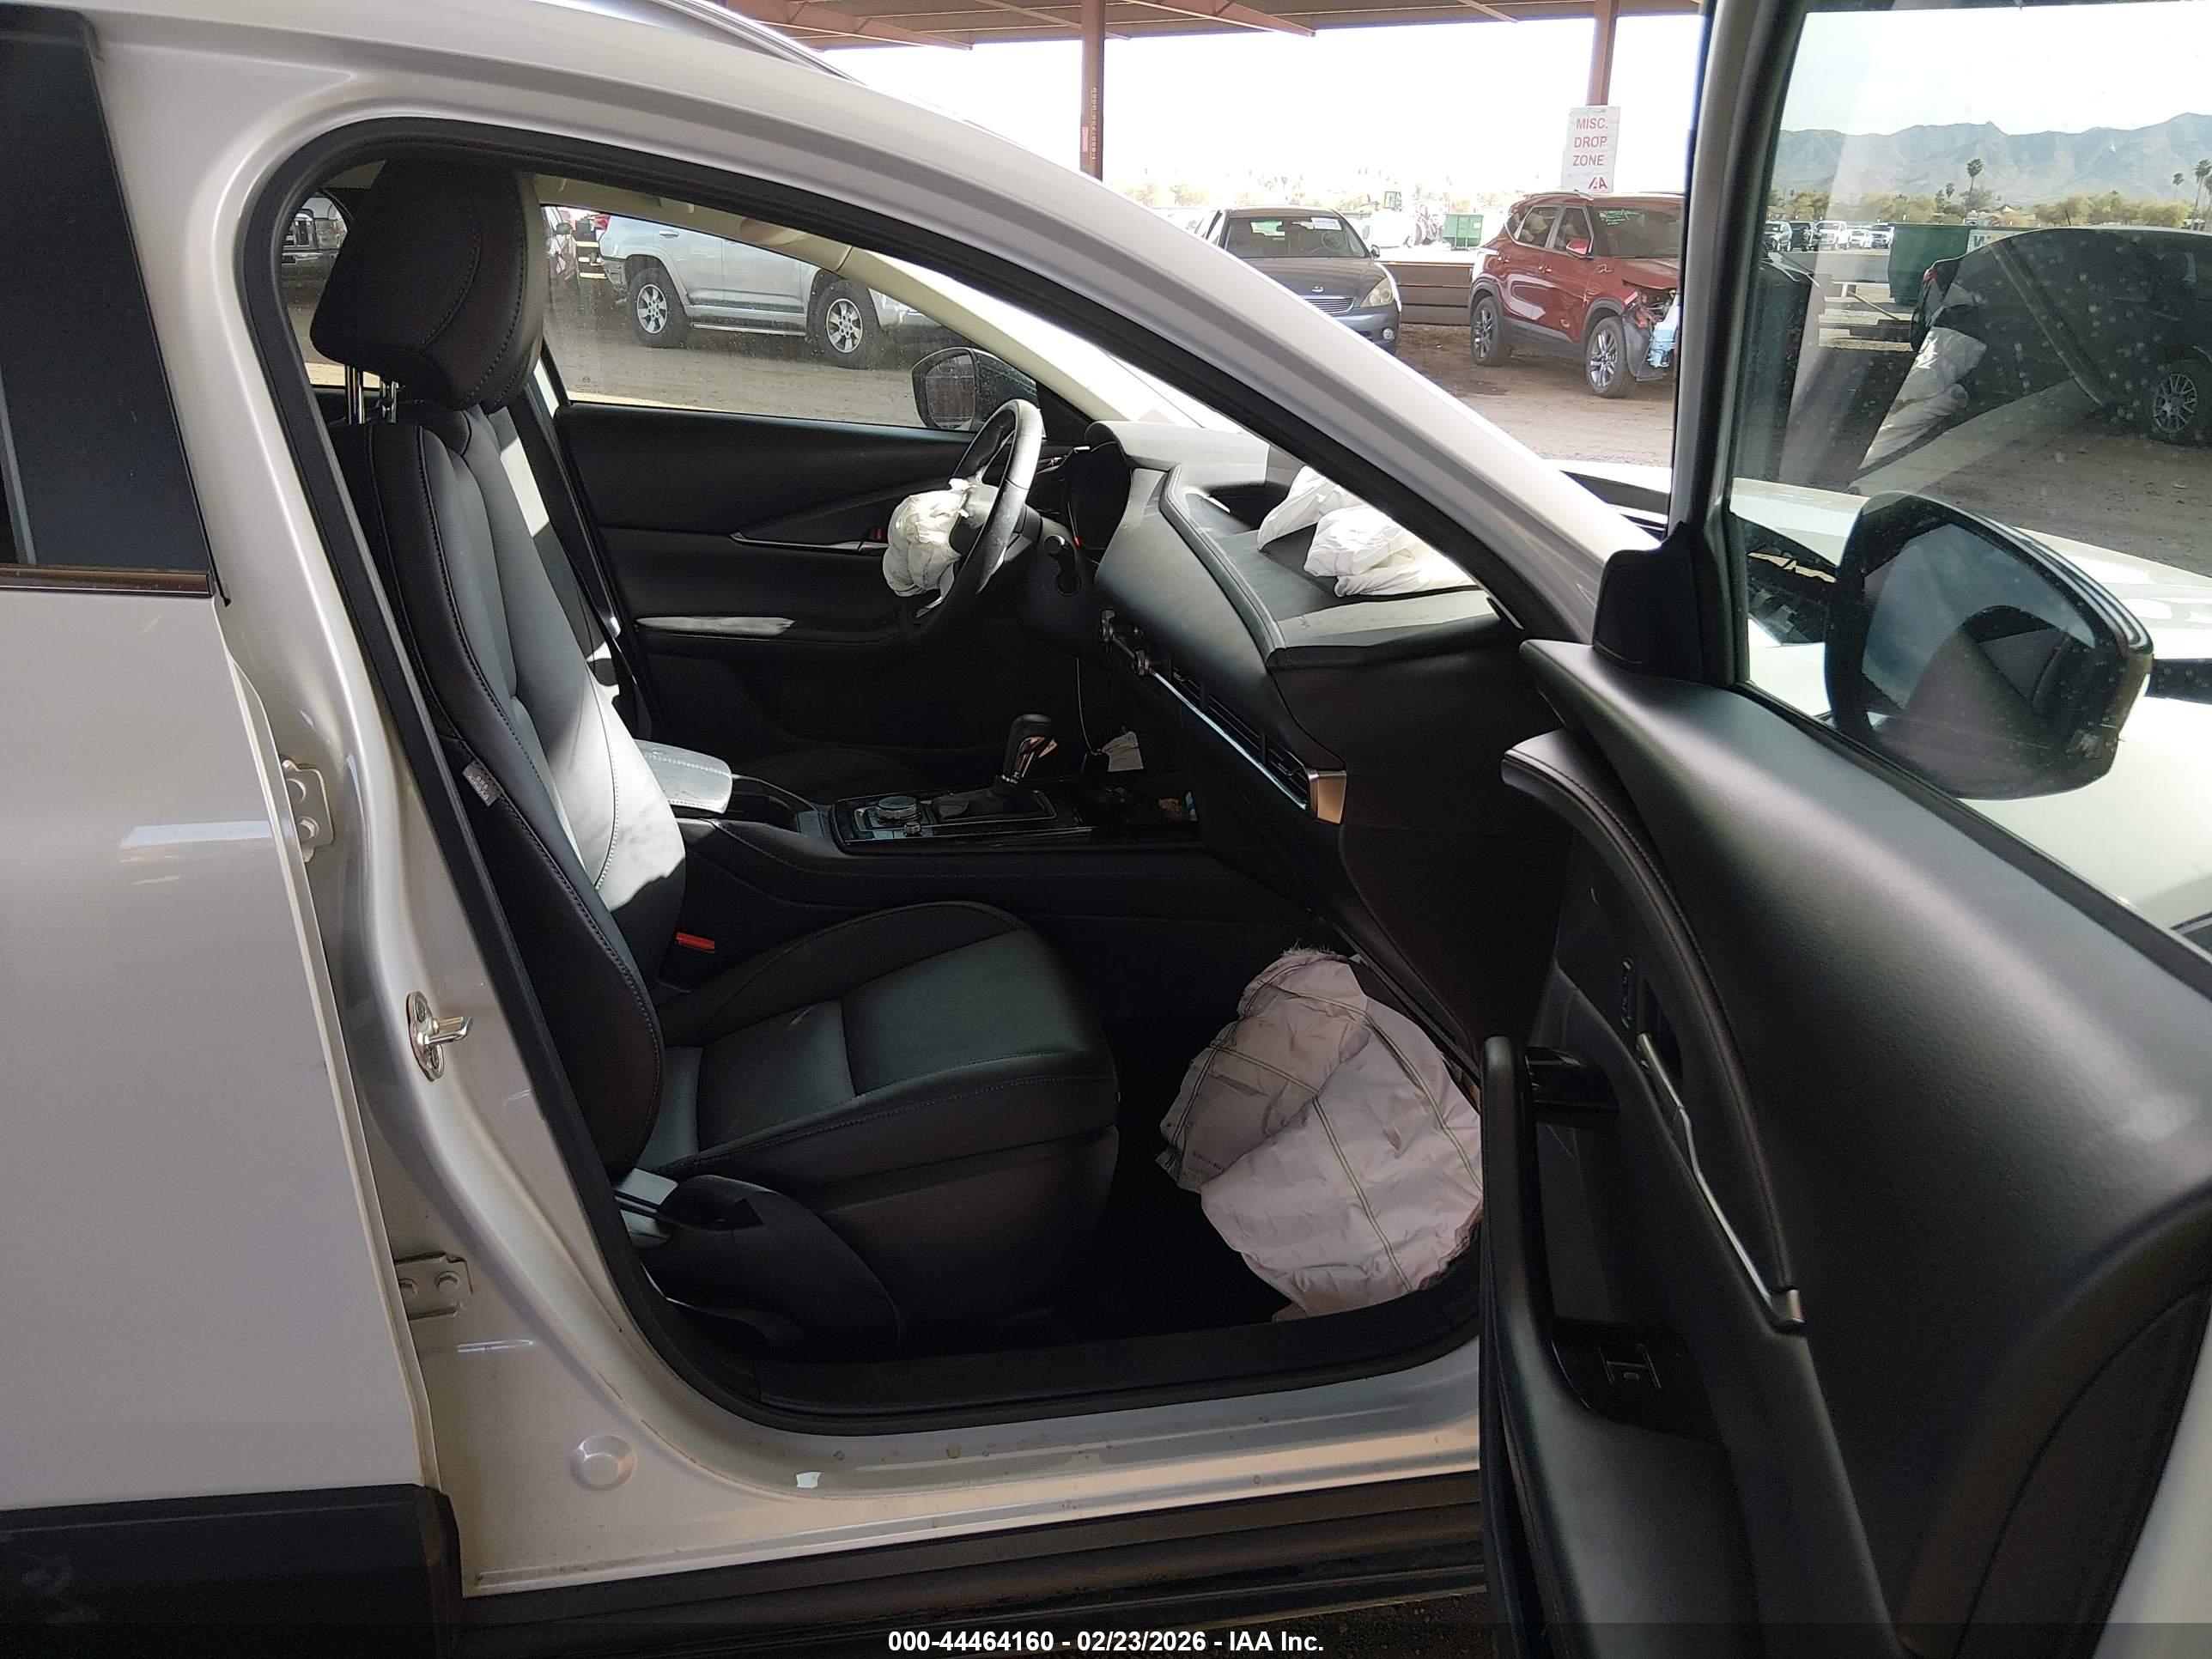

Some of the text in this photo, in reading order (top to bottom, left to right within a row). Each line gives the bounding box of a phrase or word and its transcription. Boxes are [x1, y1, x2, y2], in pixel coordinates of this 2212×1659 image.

[1576, 118, 1608, 130] MISC.
[1573, 136, 1607, 149] DROP
[1572, 155, 1605, 167] ZONE
